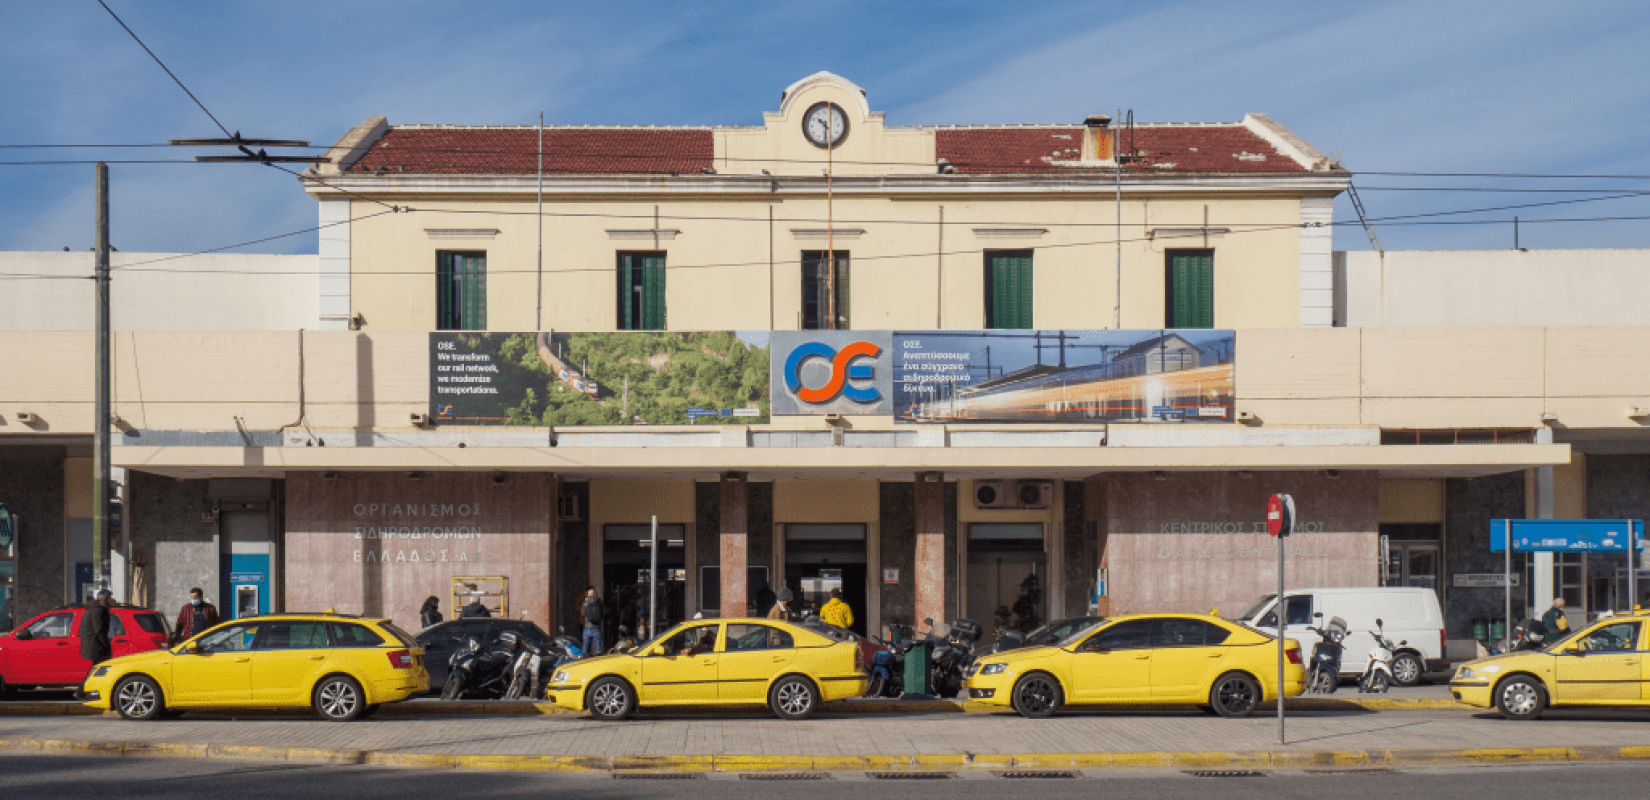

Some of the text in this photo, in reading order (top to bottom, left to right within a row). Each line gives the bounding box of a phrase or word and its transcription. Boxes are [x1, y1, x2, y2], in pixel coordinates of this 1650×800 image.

[438, 341, 457, 351] OSE.
[438, 352, 491, 362] We transform
[452, 363, 465, 372] rail
[465, 363, 499, 374] network,
[450, 374, 492, 383] modernize
[437, 384, 499, 396] transportations.
[353, 503, 482, 517] ΟΡΓΑΝΙΣΜΟΣ
[354, 526, 483, 540] ΣΙΔΗΡΟΔΡΟΜΩΝ
[1159, 521, 1326, 534] ΚΕΝΤΡΙΚΟΣ ΣΤΜΟΣ
[353, 550, 449, 563] ΕΛΛΑΔΟΣ
[1159, 548, 1212, 560] GARE
